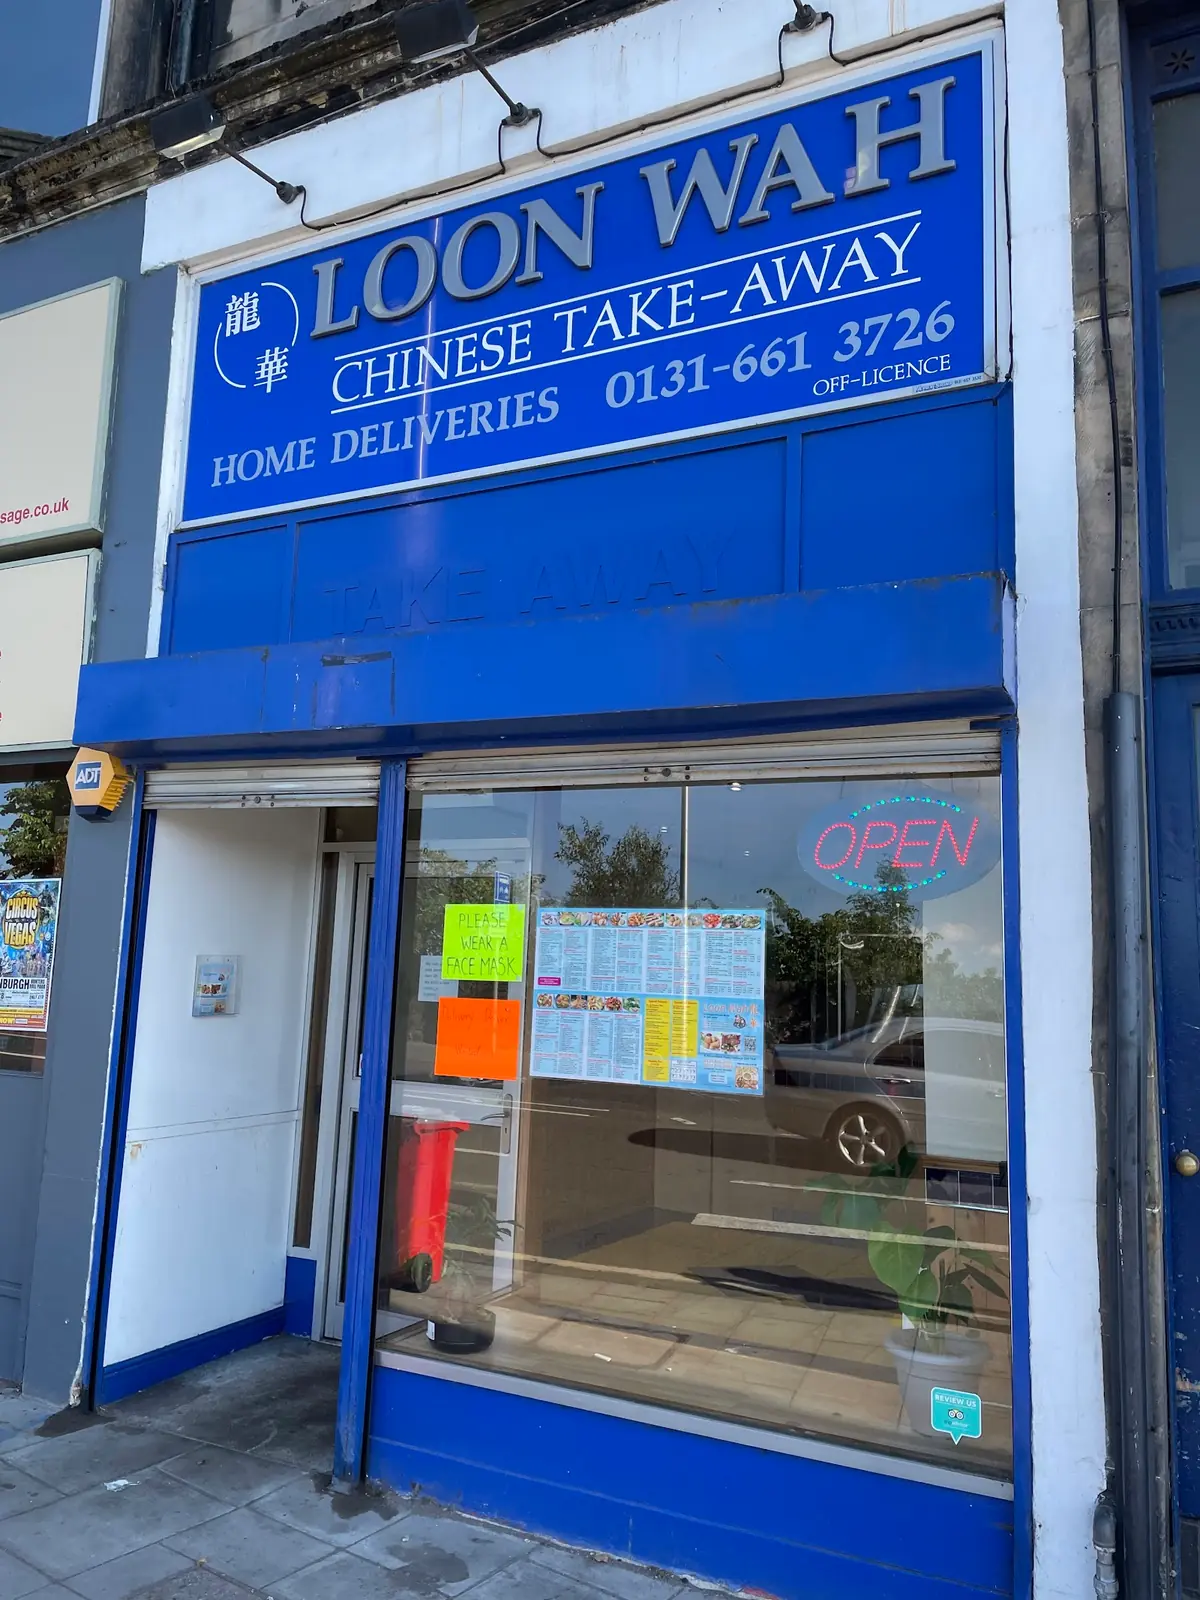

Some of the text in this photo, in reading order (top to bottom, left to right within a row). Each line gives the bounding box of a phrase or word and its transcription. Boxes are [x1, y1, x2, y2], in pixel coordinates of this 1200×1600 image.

[310, 75, 957, 339] LOON WAH
[224, 291, 261, 338] 龍
[331, 221, 922, 403] CHINESE TAKE-AWAY
[253, 346, 290, 394] 華
[812, 353, 952, 397] OFF-LICENCE
[211, 300, 956, 488] HOME DELIVERIES 0131-661 3726
[0, 498, 70, 523] sage.co.uk
[322, 532, 737, 637] TAKE AWAY
[76, 766, 102, 786] ADT
[814, 816, 980, 870] OPEN
[5, 896, 39, 920] CIRCUS
[458, 912, 508, 931] PLEASE
[4, 921, 37, 946] VEGAS
[461, 935, 509, 951] WEAR A
[446, 956, 518, 977] FACE MASK
[935, 1394, 977, 1408] REVIEW US
